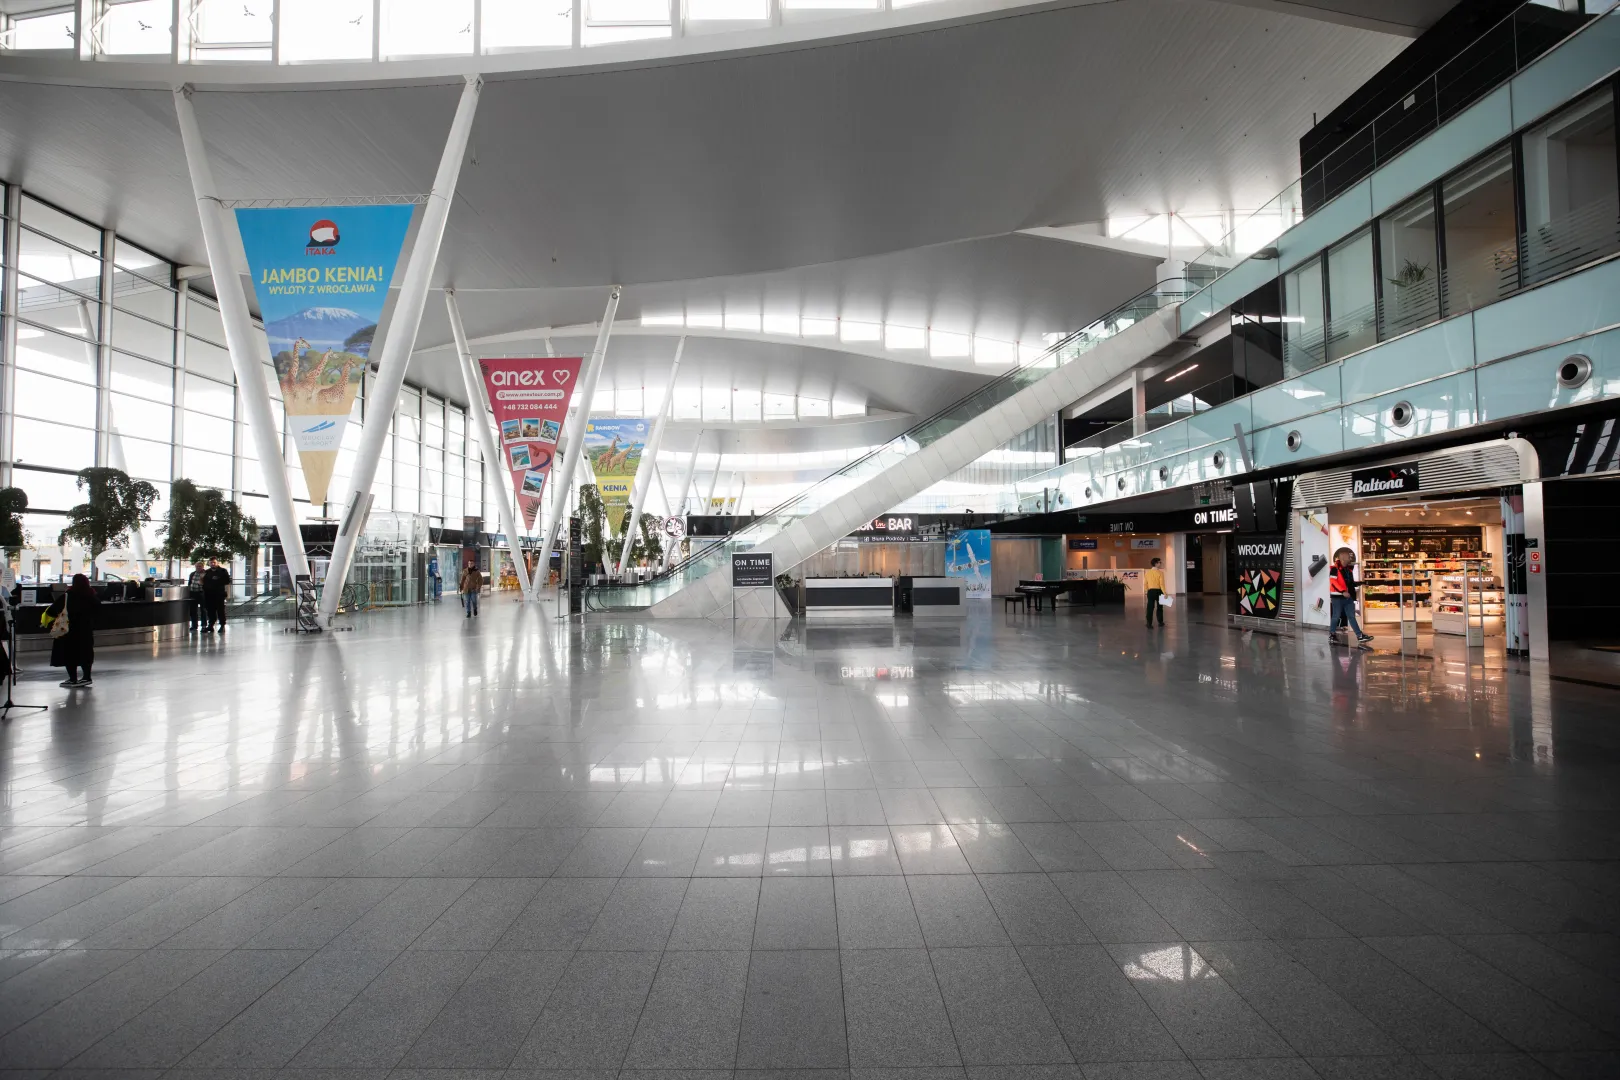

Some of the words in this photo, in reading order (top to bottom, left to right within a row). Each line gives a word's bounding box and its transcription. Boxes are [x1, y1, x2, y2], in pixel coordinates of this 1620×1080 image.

[305, 248, 336, 256] ITAKA
[261, 267, 320, 284] JAMBO
[325, 266, 383, 282] KENIA!
[269, 285, 306, 295] WYLOTY
[308, 286, 315, 294] Z
[317, 284, 376, 294] WROCŁAWIA
[491, 370, 546, 386] anex
[603, 484, 628, 492] KENIA
[1353, 477, 1405, 494] Baltona
[1194, 512, 1208, 524] ON
[1210, 509, 1234, 523] TIME
[888, 518, 912, 531] BAR
[1237, 543, 1282, 556] WROCŁAW
[750, 558, 770, 566] TIME
